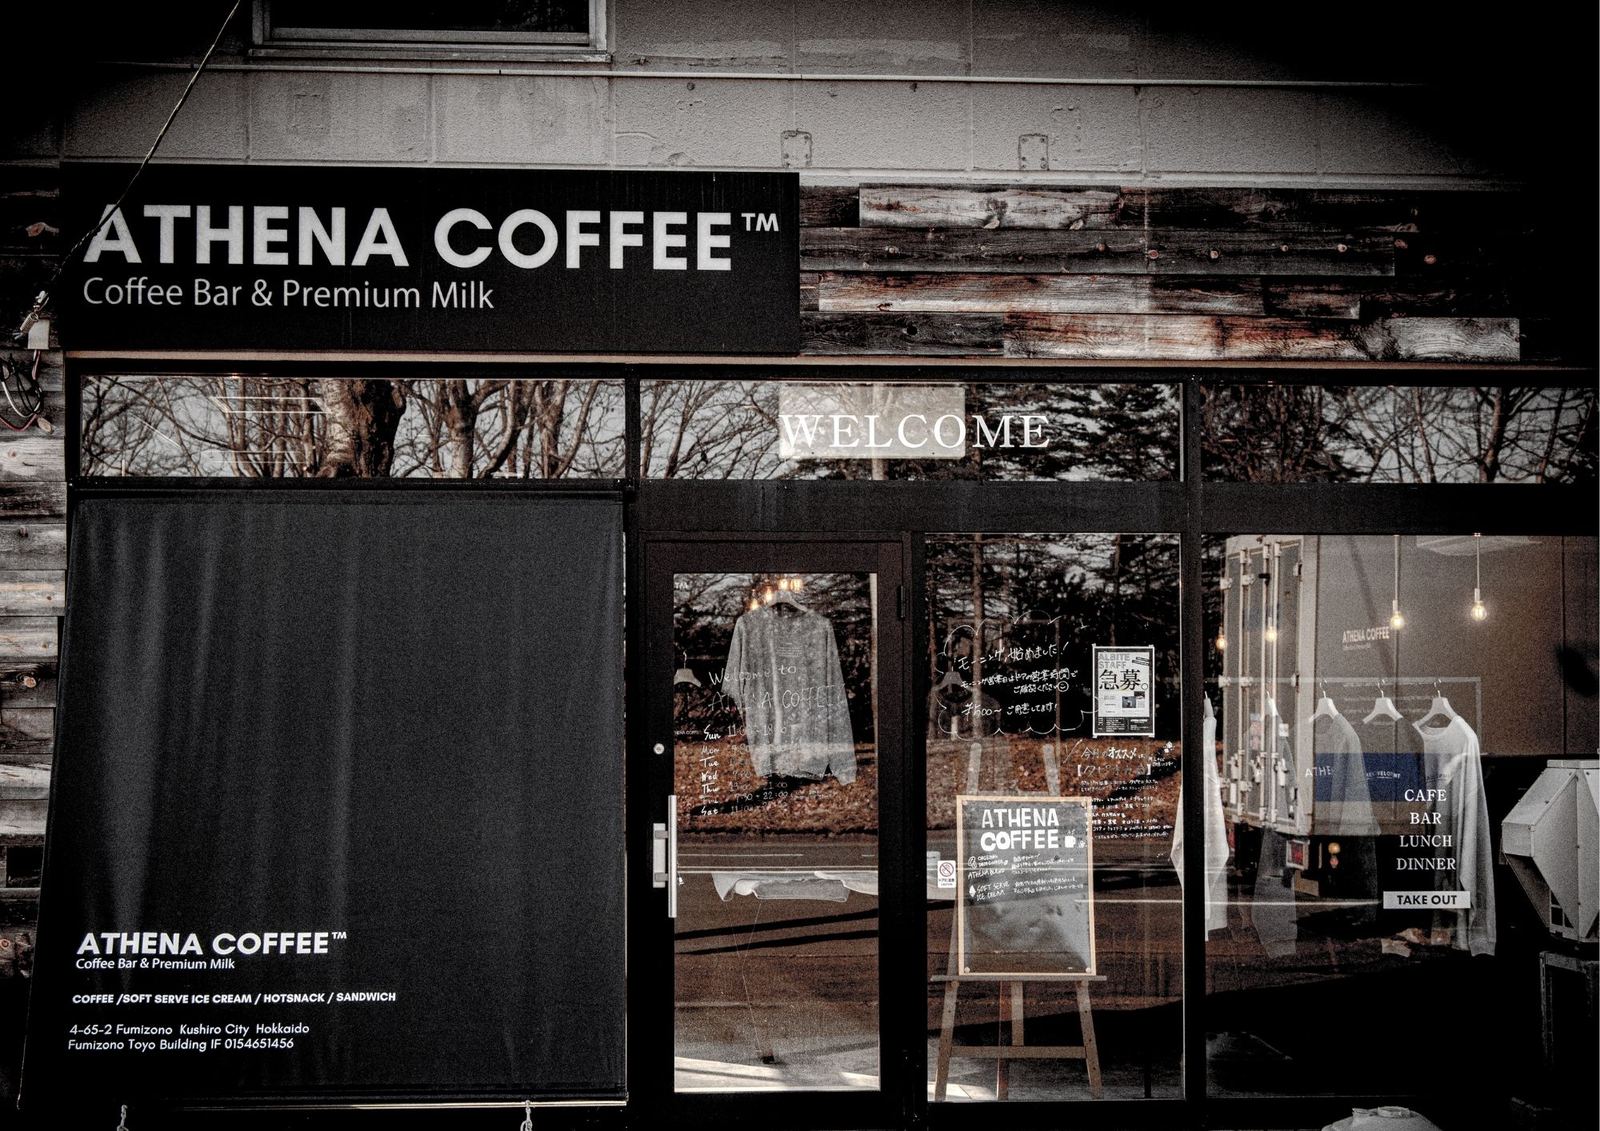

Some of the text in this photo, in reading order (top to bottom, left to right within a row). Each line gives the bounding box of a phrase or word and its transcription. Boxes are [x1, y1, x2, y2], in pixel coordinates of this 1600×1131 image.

[82, 204, 410, 267] ATHENA
[83, 276, 495, 309] Coffee Bar & Premium Milk
[778, 414, 1051, 449] WELCOME
[778, 664, 797, 676] to
[703, 724, 722, 741] Sun
[699, 755, 720, 768] Tue
[1404, 788, 1447, 802] CAFE
[981, 808, 1060, 829] ATHENA
[1410, 812, 1442, 825] BAR
[980, 829, 1059, 851] COFFEE
[1400, 834, 1453, 848] LUNCH
[1396, 857, 1457, 871] DINNER
[1396, 894, 1458, 906] TAKE OUT
[76, 932, 204, 955] ATHENA
[76, 957, 236, 970] Coffee Bar & Premium Milk
[72, 994, 114, 1004] COFFEE
[154, 994, 189, 1004] SERVE
[191, 994, 210, 1004] ICE
[212, 993, 252, 1004] CREAM
[263, 992, 325, 1003] HOTSNACK
[336, 992, 397, 1002] SANDWICH
[69, 1021, 310, 1037] 4-65-2 Fumizono Kushiro City Hokkaido
[68, 1039, 125, 1050] Fumizono
[128, 1038, 156, 1053] Toyo
[159, 1038, 207, 1053] Building
[224, 1037, 295, 1050] 0154651456
